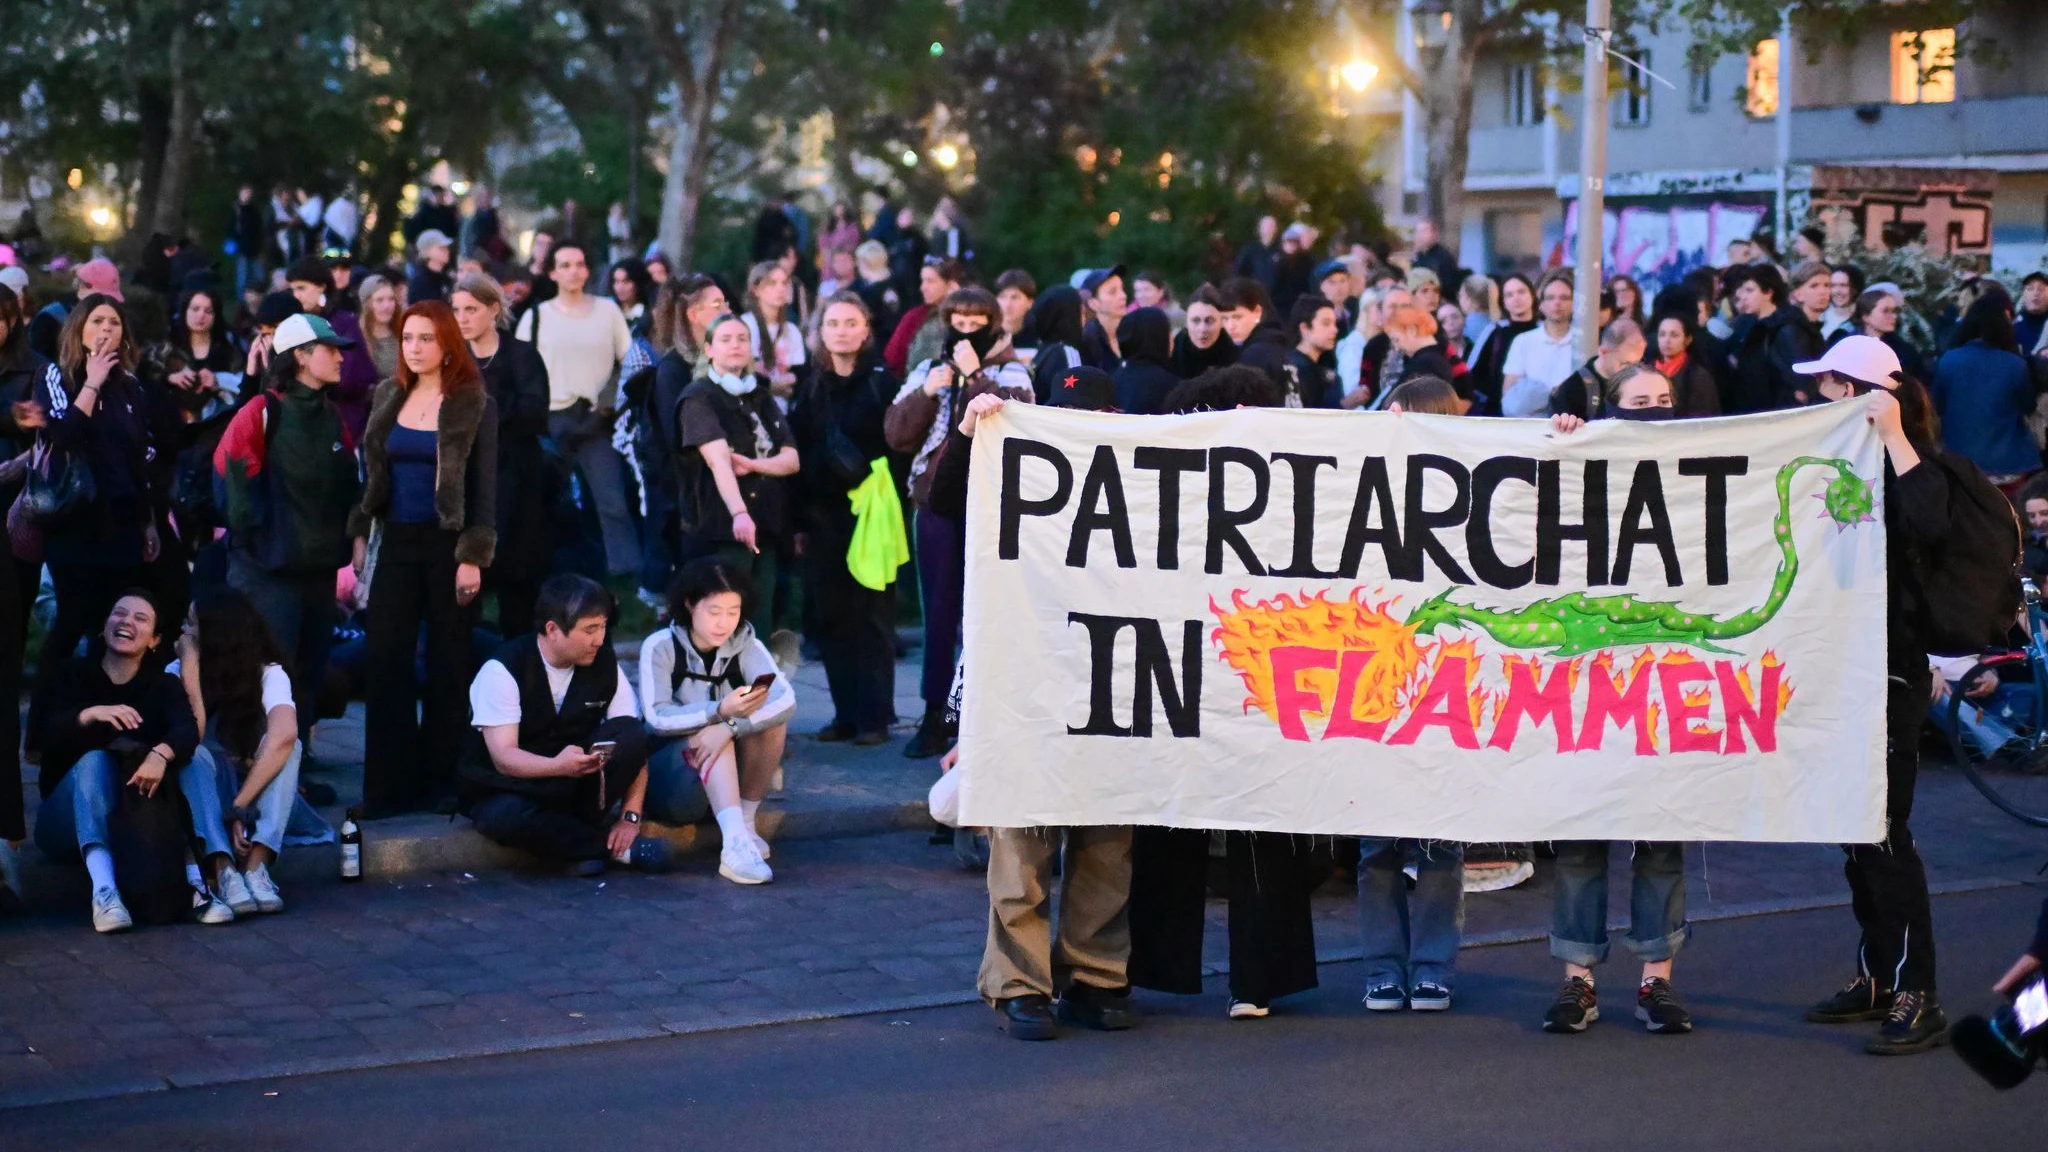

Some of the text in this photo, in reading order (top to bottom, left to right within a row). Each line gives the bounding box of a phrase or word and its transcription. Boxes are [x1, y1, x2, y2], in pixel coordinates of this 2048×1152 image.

[998, 437, 1749, 589] PATRIARCHAT
[1066, 611, 1203, 738] IN
[1269, 646, 1786, 756] FLAMMEN
